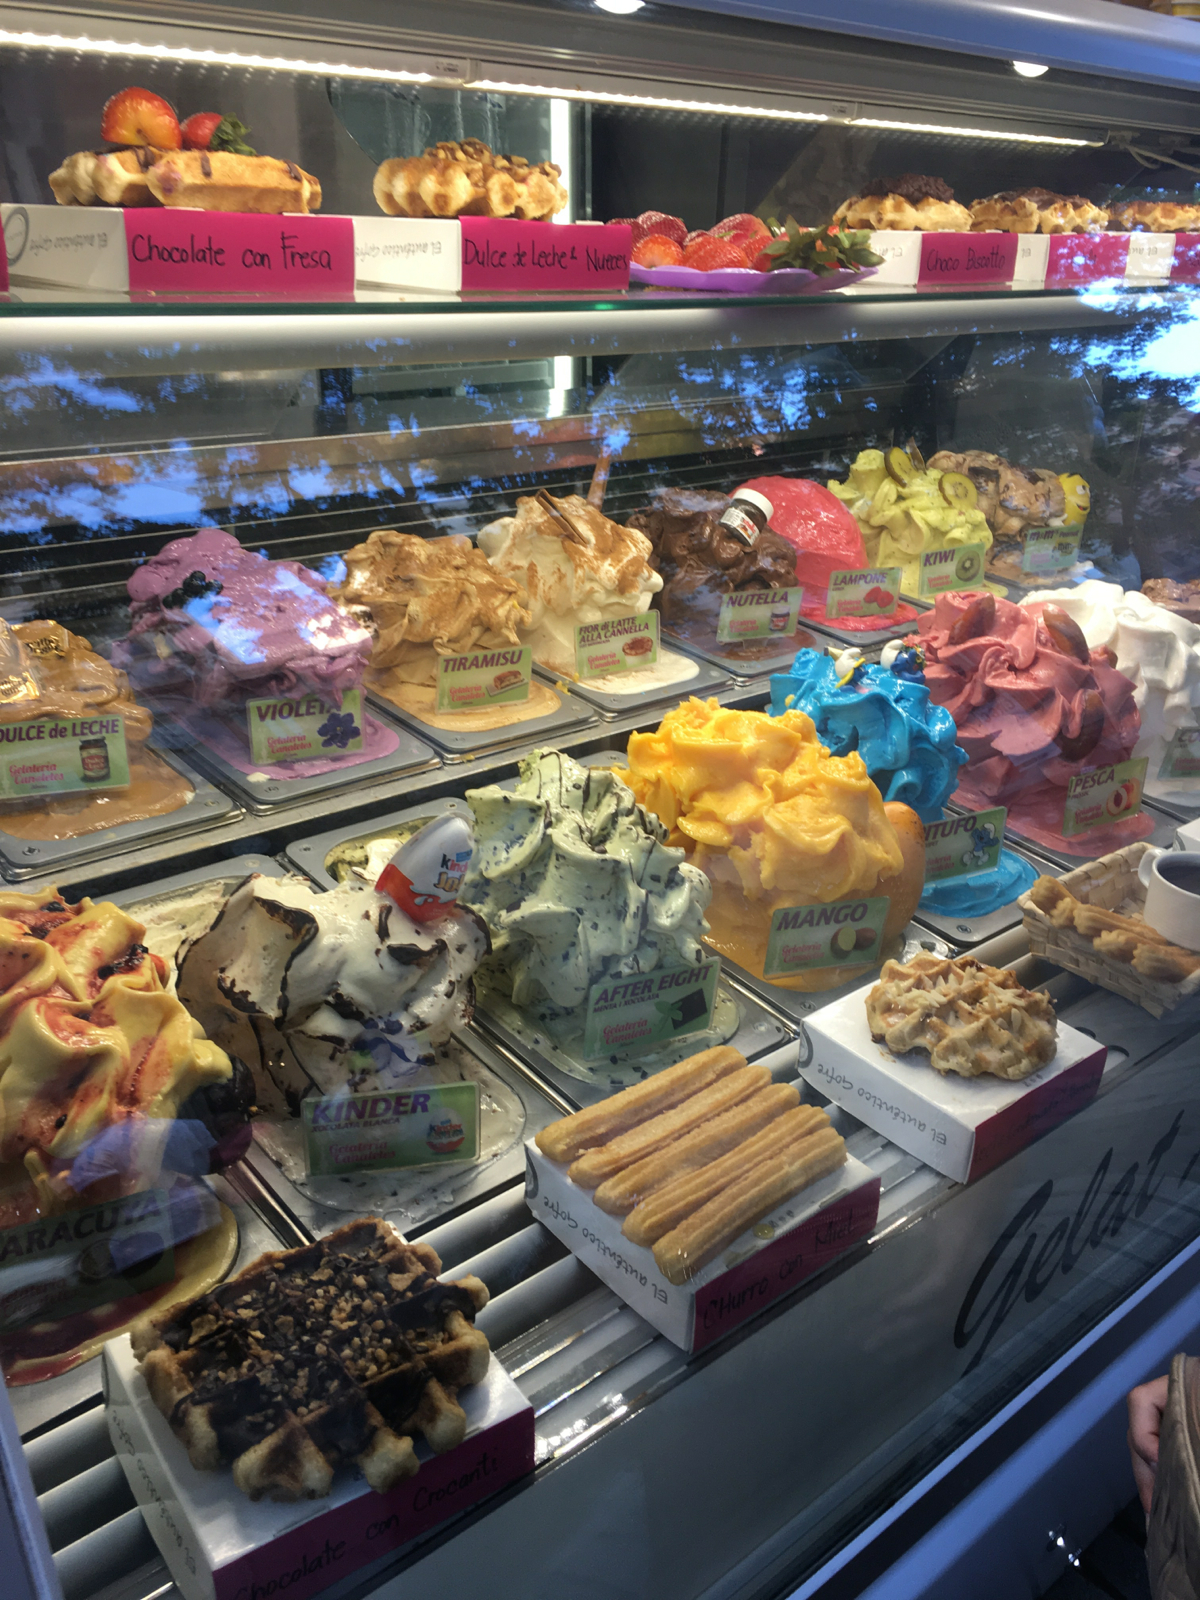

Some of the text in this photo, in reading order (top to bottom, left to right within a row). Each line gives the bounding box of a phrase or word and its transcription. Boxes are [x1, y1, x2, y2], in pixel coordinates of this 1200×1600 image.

[132, 231, 333, 271] Chocolate con Fresa
[463, 238, 507, 268] Dulce
[532, 240, 568, 269] Leche
[926, 248, 960, 273] Choco
[923, 549, 956, 568] KIWI
[833, 571, 888, 587] LAMPONE
[726, 591, 789, 609] NUTELLA
[579, 623, 599, 636] FIOR
[611, 616, 638, 630] LATTE
[579, 631, 602, 645] ALLA
[604, 622, 649, 639] CANNELLA
[443, 650, 523, 673] TIRAMISU
[256, 699, 333, 722] VIOLET
[48, 723, 68, 739] de
[72, 718, 120, 737] LECHE
[1073, 768, 1115, 792] PESCA
[924, 816, 977, 841] ITUFO
[776, 903, 868, 931] MANGO
[594, 964, 714, 1006] AFTER EIGHT
[603, 1018, 648, 1037] Gelateria
[604, 1028, 652, 1045] Canaletes
[311, 1093, 431, 1125] KINDER
[857, 1087, 927, 1132] auténtico
[0, 1195, 162, 1262] ARACUYA
[582, 1227, 648, 1287] auténtico
[233, 1446, 499, 1600] Chocolate con Crocanti
